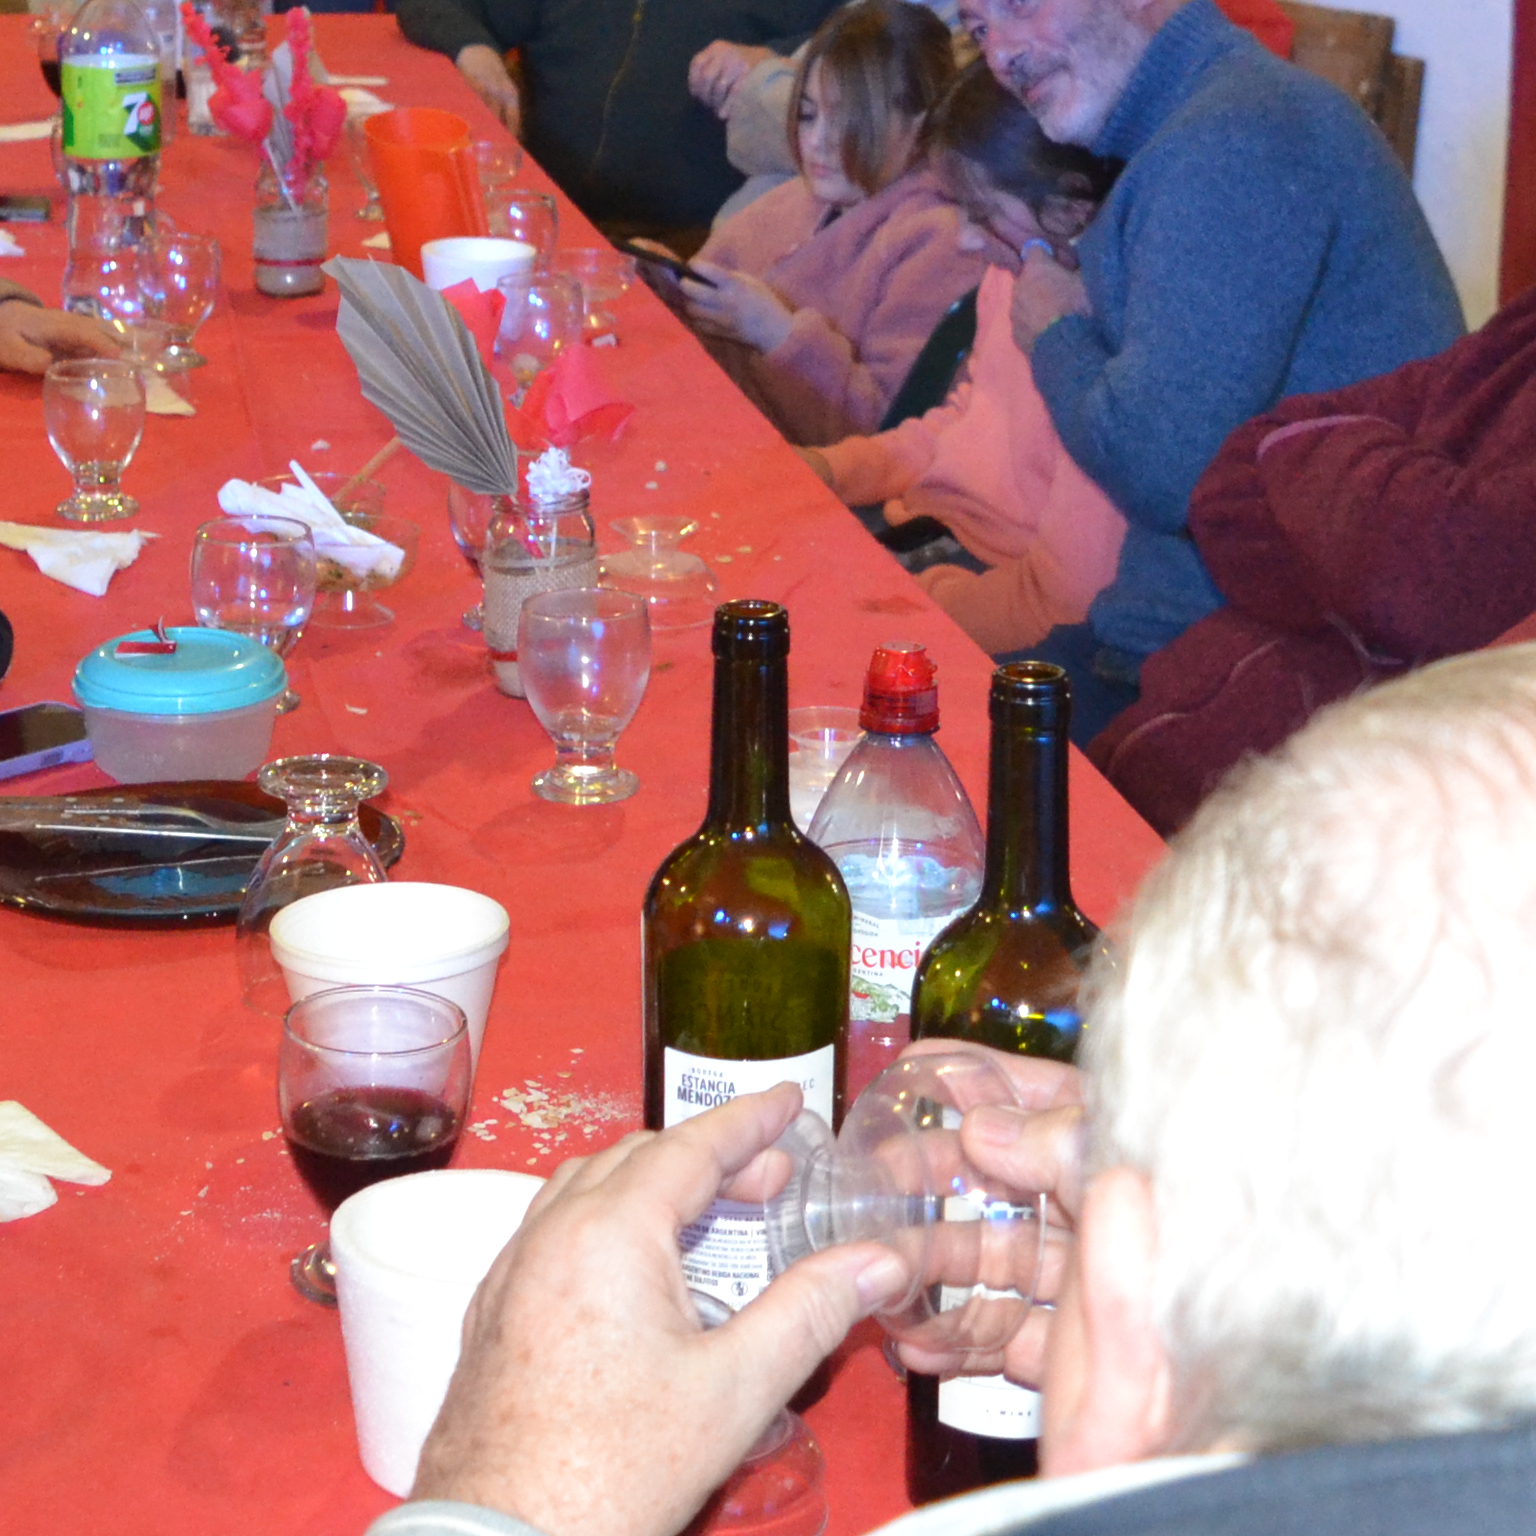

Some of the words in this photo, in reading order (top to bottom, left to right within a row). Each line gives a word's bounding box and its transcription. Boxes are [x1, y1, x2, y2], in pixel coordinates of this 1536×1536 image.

[851, 941, 922, 970] cenci
[853, 968, 884, 977] GENTINA
[681, 1074, 736, 1094] ESTANCIA
[677, 1086, 738, 1107] MENDOZ
